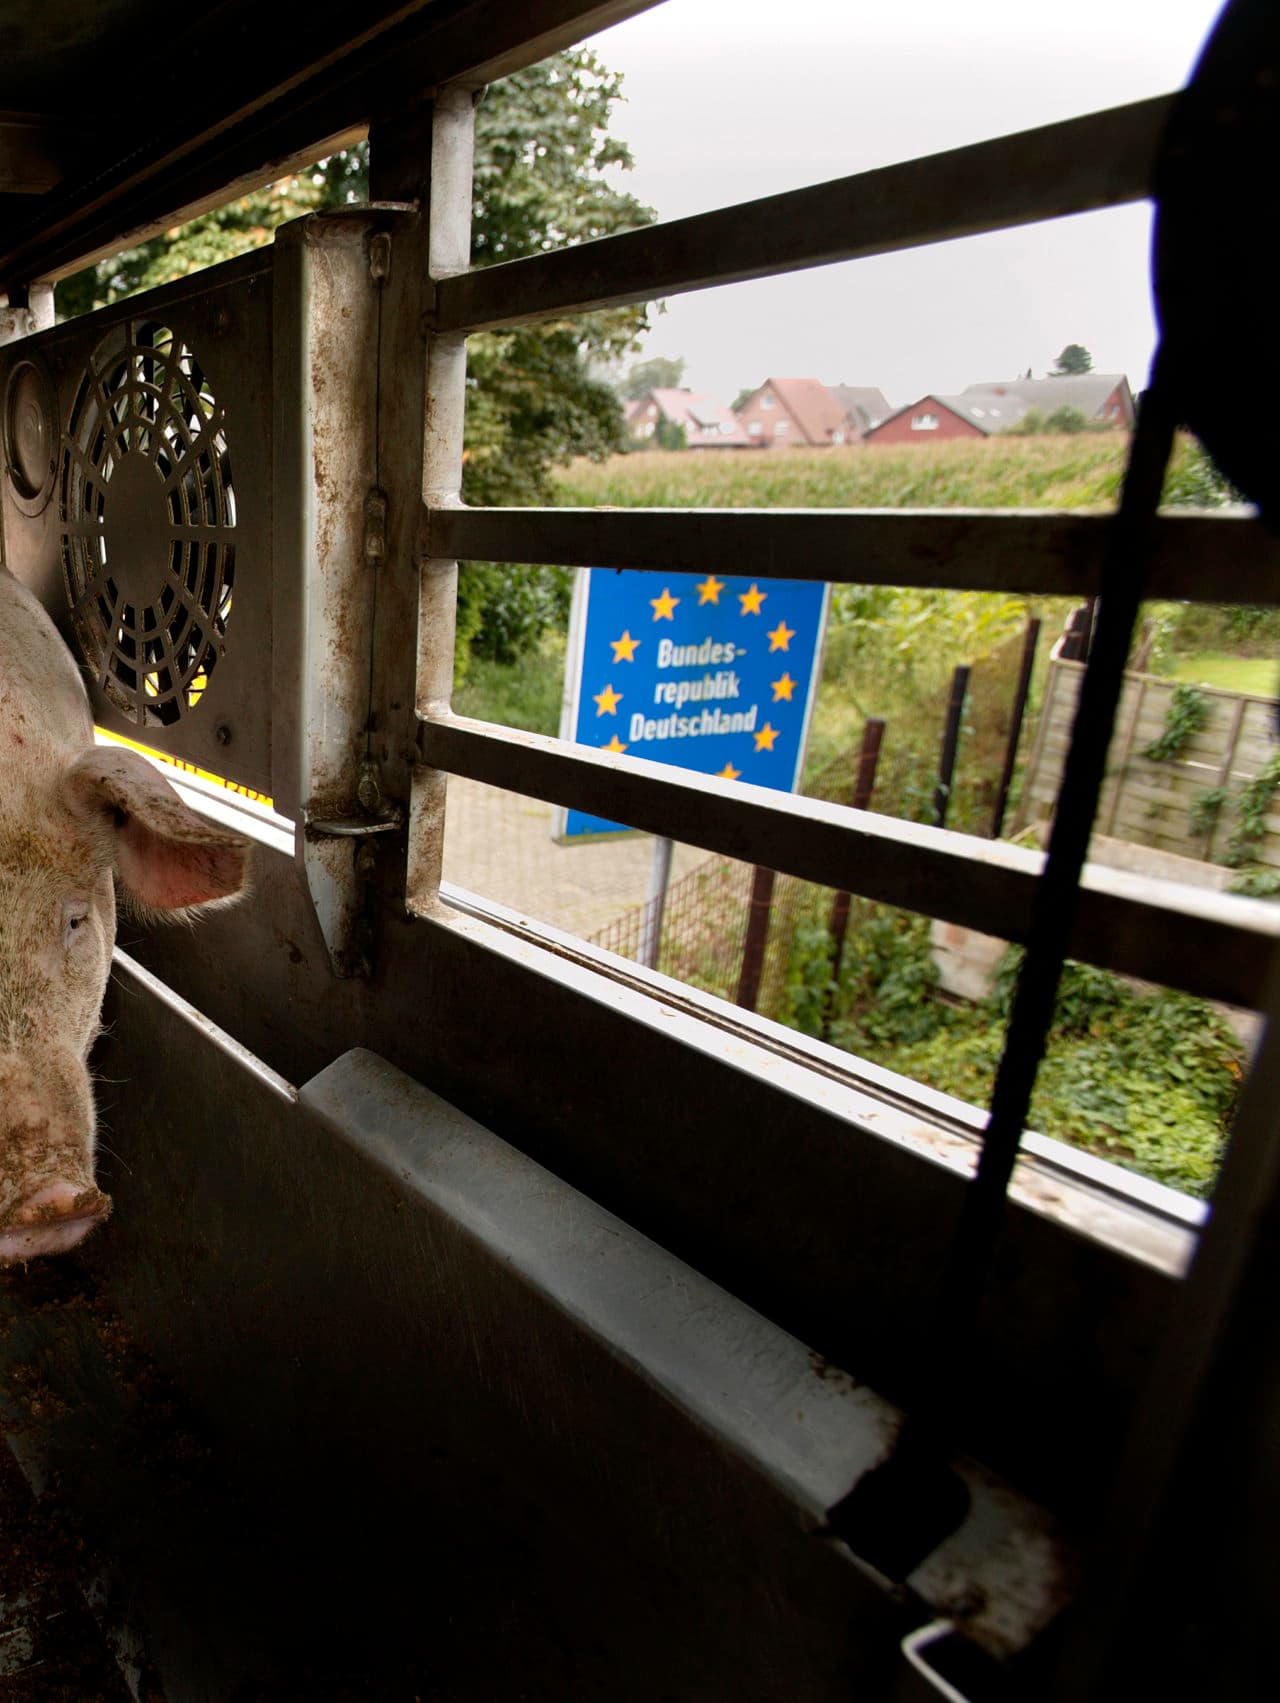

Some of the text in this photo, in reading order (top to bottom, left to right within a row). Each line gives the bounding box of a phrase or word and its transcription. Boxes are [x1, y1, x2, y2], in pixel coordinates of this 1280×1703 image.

[658, 637, 747, 668] Bundes-
[654, 671, 740, 709] republik
[630, 704, 758, 741] Deutschland
